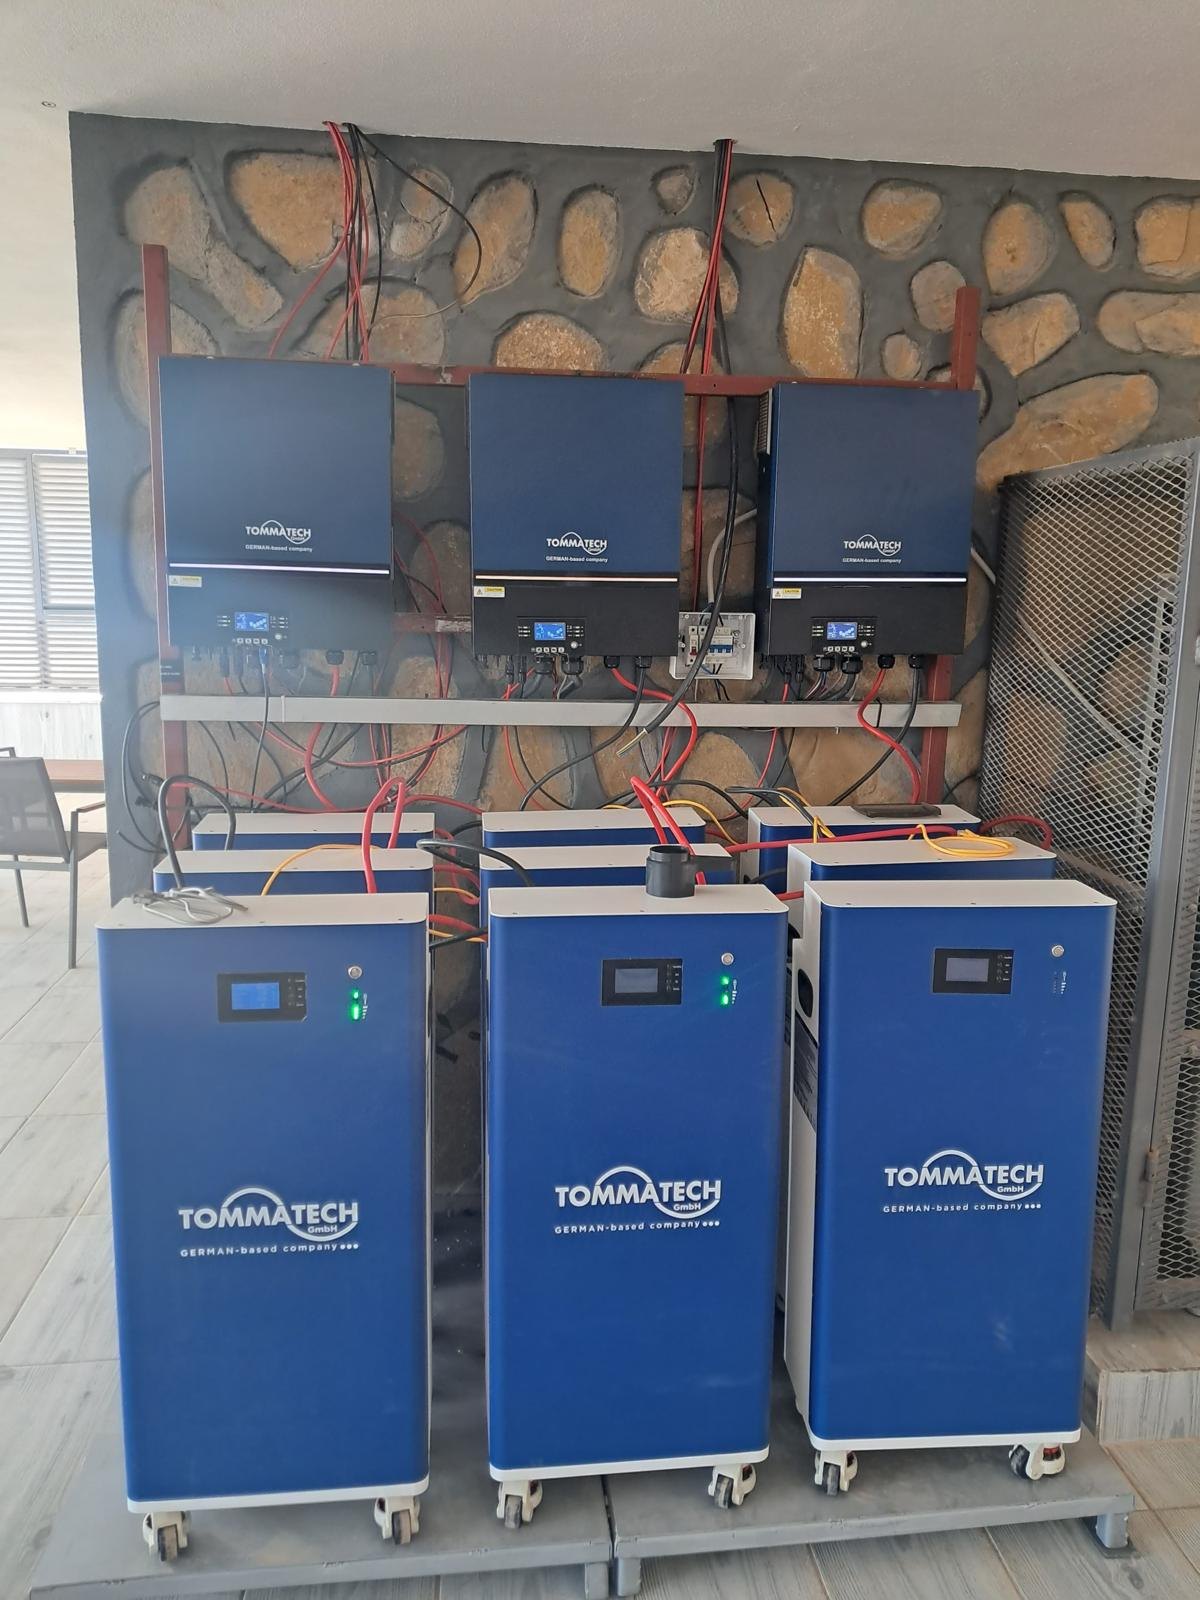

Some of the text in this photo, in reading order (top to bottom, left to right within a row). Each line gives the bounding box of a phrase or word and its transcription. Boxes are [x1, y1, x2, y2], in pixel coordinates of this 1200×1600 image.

[245, 526, 312, 537] TOMMATECH
[546, 538, 608, 548] TOMMATECH
[843, 541, 902, 549] TOMMATECH
[884, 1164, 1044, 1187] TOMMATECH
[555, 1179, 722, 1208] TOMMATECH
[997, 1185, 1024, 1193] GmbH
[673, 1203, 702, 1211] GmbH
[883, 1203, 969, 1213] GERMAN-based
[178, 1202, 358, 1230] TOMMATECH
[307, 1224, 338, 1234] GmbH
[554, 1222, 645, 1234] GERMAN-based
[180, 1245, 277, 1257] GERMAN-based
